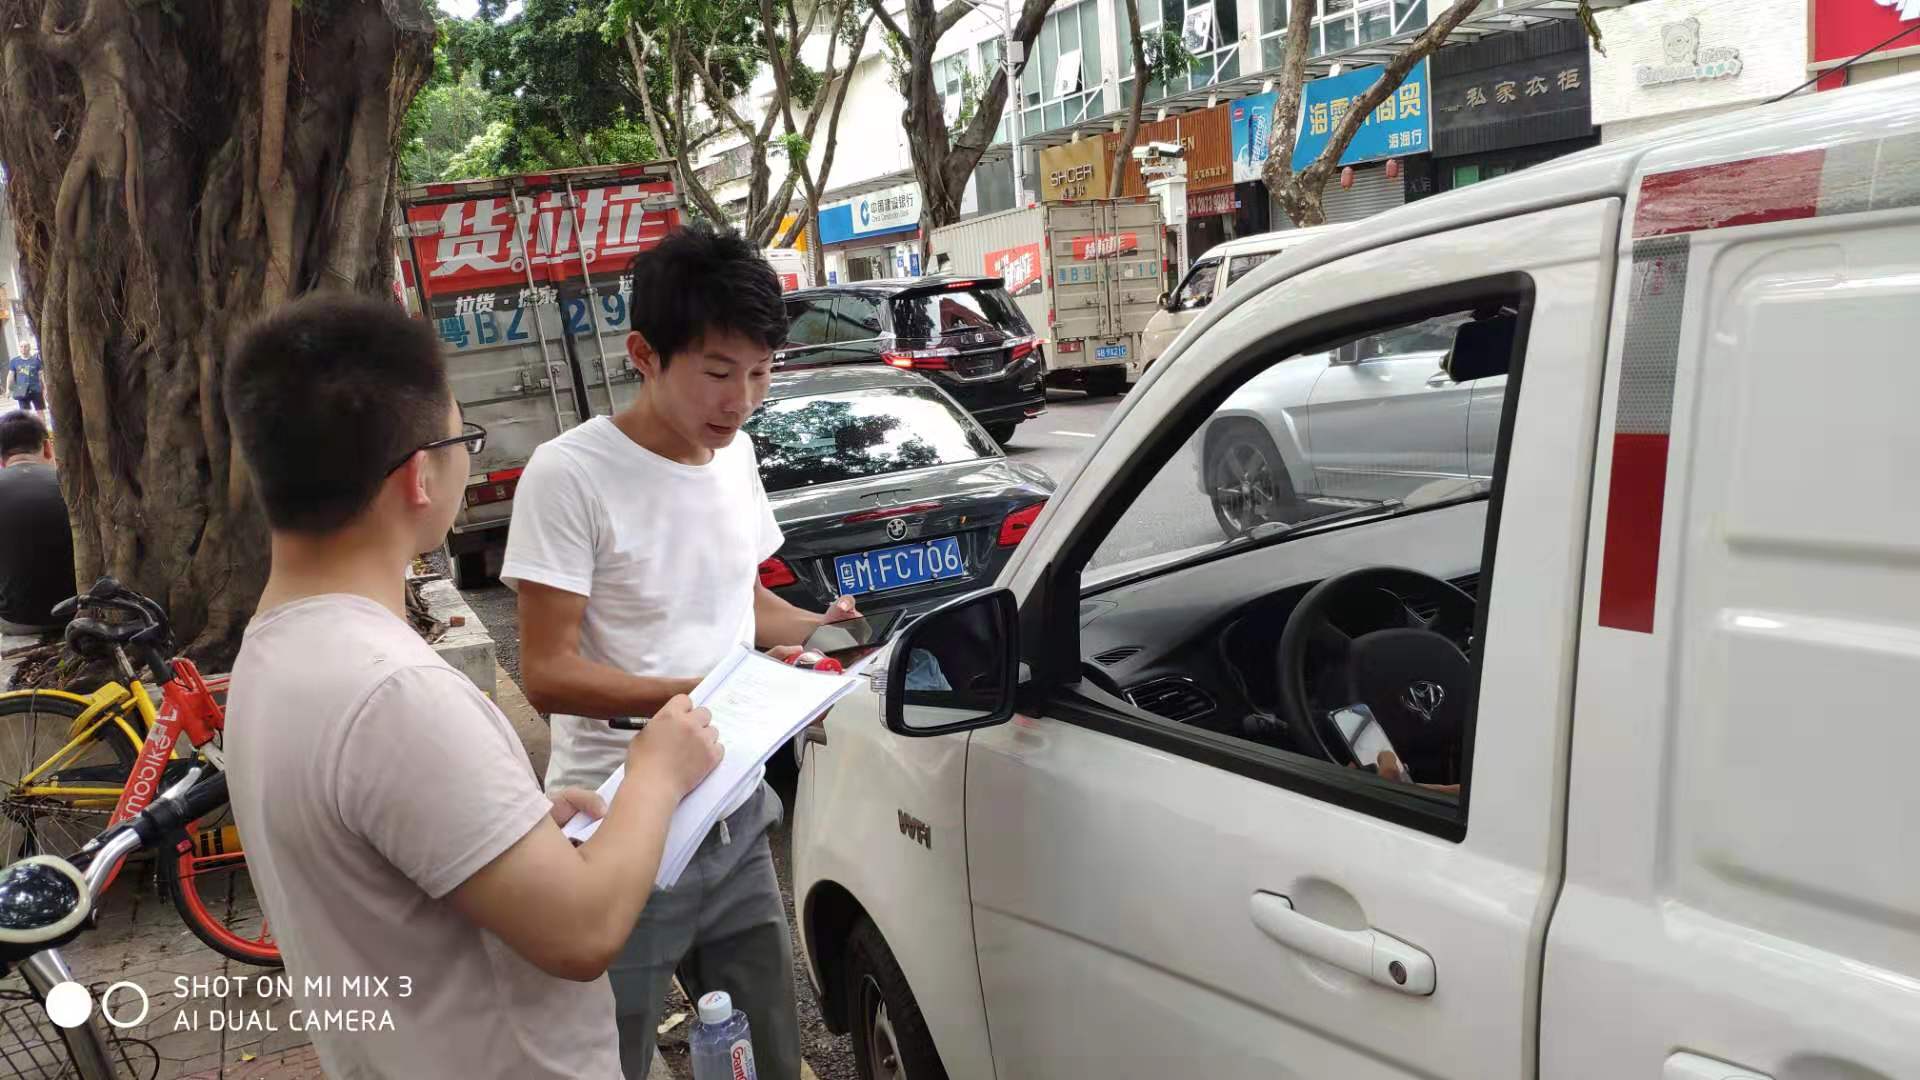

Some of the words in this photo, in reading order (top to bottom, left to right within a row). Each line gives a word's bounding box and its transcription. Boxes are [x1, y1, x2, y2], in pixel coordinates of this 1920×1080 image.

[1310, 82, 1420, 135] 海商贸
[1466, 68, 1582, 107] 私家衣柜
[430, 184, 655, 277] 货拉拉
[125, 733, 171, 819] mobike
